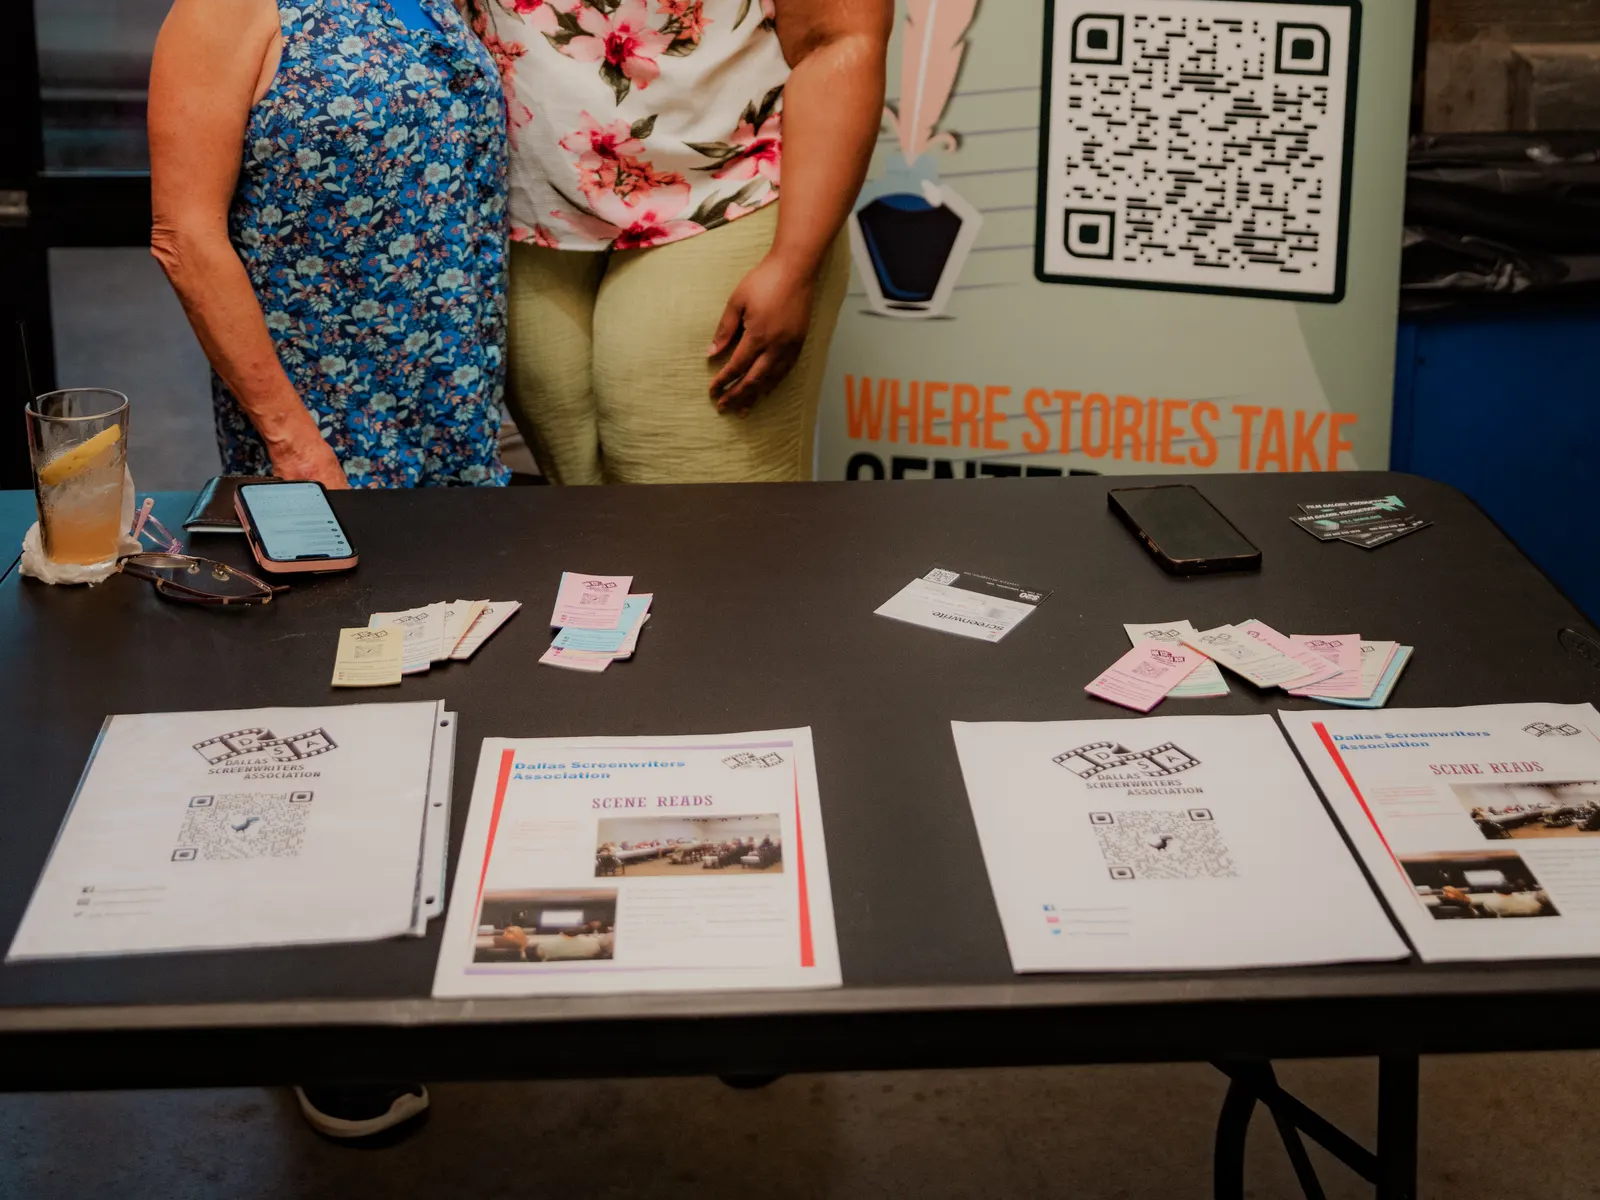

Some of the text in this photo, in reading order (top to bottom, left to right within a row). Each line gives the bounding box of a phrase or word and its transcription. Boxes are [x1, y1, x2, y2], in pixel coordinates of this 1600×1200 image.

[845, 374, 1358, 472] WHERE STORIES TAKE
[1333, 729, 1491, 741] Dallas Screenwriters
[1340, 741, 1430, 751] Association
[225, 758, 269, 766] DALLAS
[514, 759, 686, 770] Dallas Screenwriters
[207, 764, 305, 775] SCREENWRITERS
[1429, 760, 1545, 776] SCENE READS
[243, 771, 321, 780] ASSOCIATION
[512, 771, 611, 780] Association
[1097, 772, 1141, 781] DALLAS
[1086, 779, 1183, 789] SCREENWRITERS
[1127, 786, 1204, 796] ASSOCIATION
[591, 794, 714, 810] SCENE READS
